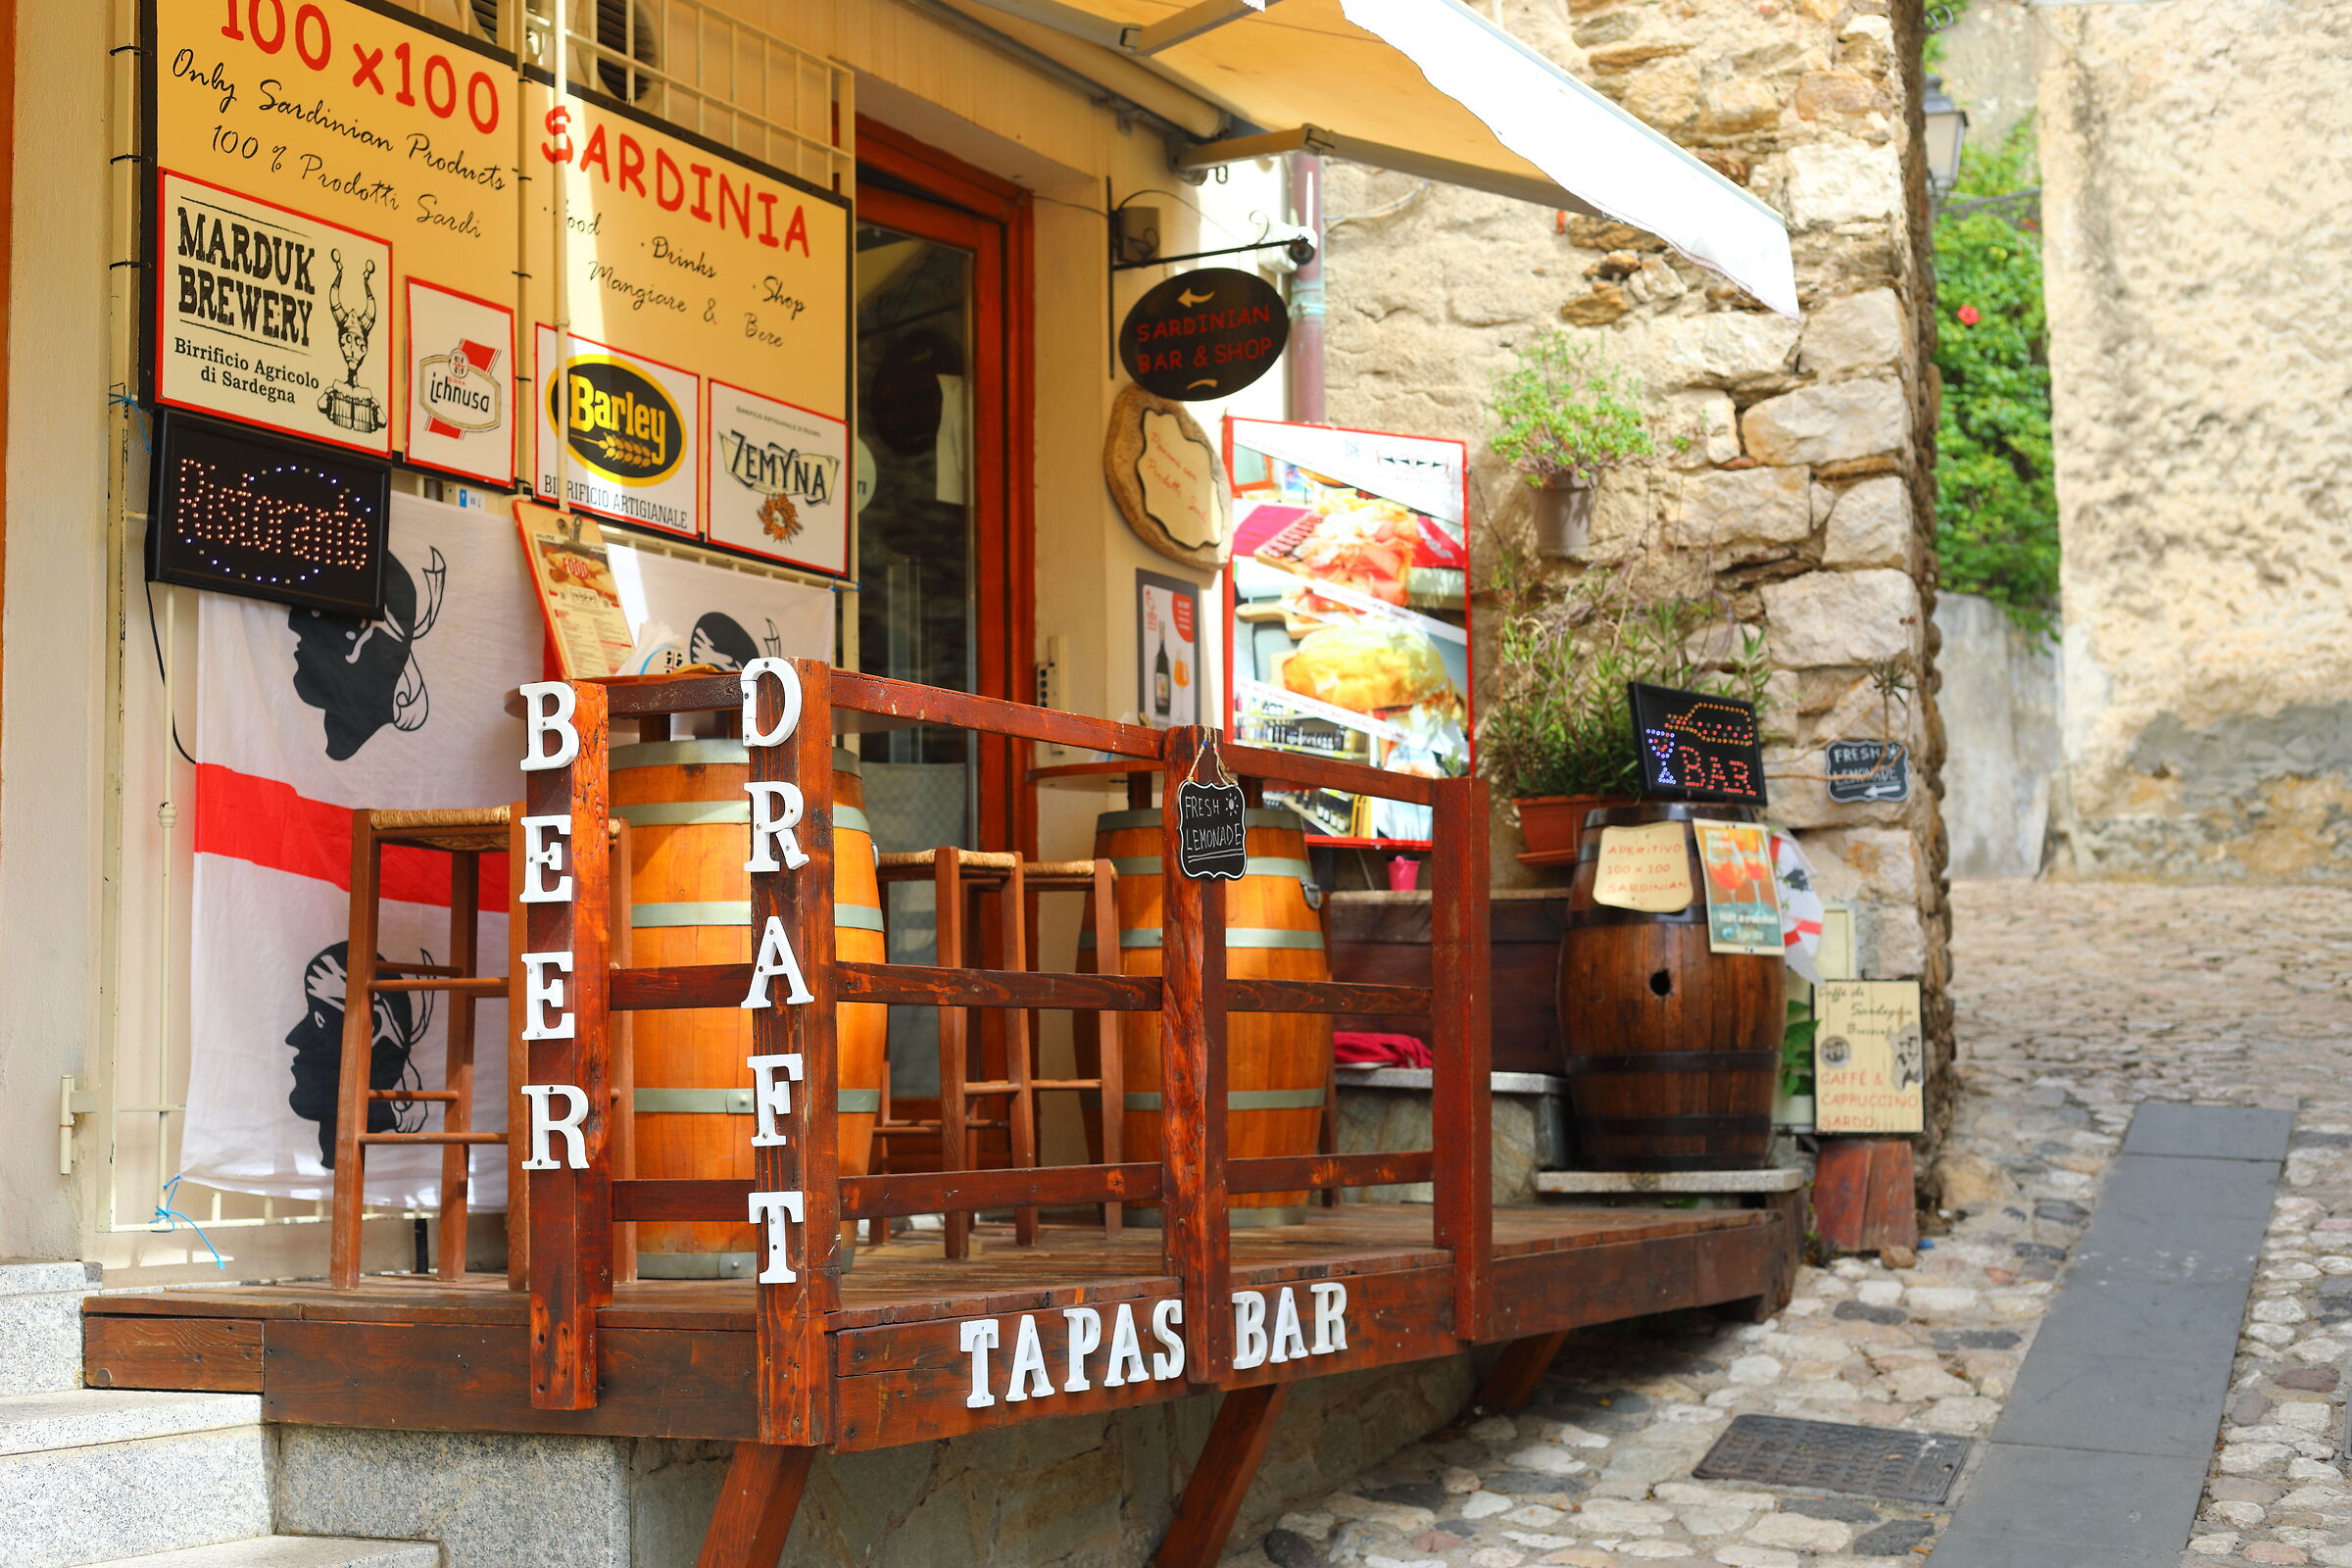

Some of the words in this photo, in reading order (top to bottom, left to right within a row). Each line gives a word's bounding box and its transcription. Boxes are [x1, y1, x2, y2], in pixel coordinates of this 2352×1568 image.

[221, 0, 331, 71] 100
[172, 48, 236, 113] Only
[259, 78, 393, 152] Sardinian
[407, 132, 506, 190] Products
[212, 124, 259, 159] 100
[300, 153, 400, 211] Prodotti
[416, 193, 481, 238] Sardi
[541, 105, 809, 258] SARDINIA
[554, 199, 602, 235] ood
[177, 206, 316, 295] MARDUK
[177, 264, 313, 347] BREWERY
[588, 260, 686, 313] Mangiare
[744, 312, 784, 348] Bere
[1136, 305, 1270, 342] SARDINIAN
[174, 336, 250, 372] Birrificio
[254, 359, 319, 389] Agricolo
[200, 366, 217, 383] di
[221, 370, 296, 404] Sardegna
[1138, 350, 1183, 373] BAR
[1193, 345, 1207, 368] &
[1214, 337, 1272, 365] SHOP
[430, 371, 490, 413] ichnusa
[569, 373, 665, 466] Barley
[731, 429, 826, 505] ZEMYNA
[177, 458, 368, 570] Ristorante
[544, 474, 610, 509] BIRIFICIO
[613, 493, 687, 530] ARTIGIANALE
[1679, 746, 1756, 796] BAR
[1834, 747, 1880, 763] FRESH
[1185, 796, 1220, 819] FRESH
[1186, 823, 1242, 851] LEMONADE
[1607, 864, 1631, 875] 100
[1647, 863, 1671, 875] 100
[519, 681, 590, 1171] BEER
[741, 658, 815, 1284] DRAFT
[1820, 1093, 1919, 1109] CAPPUCCINO
[959, 1298, 1185, 1408] TAPAS
[1232, 1282, 1348, 1370] BAR
